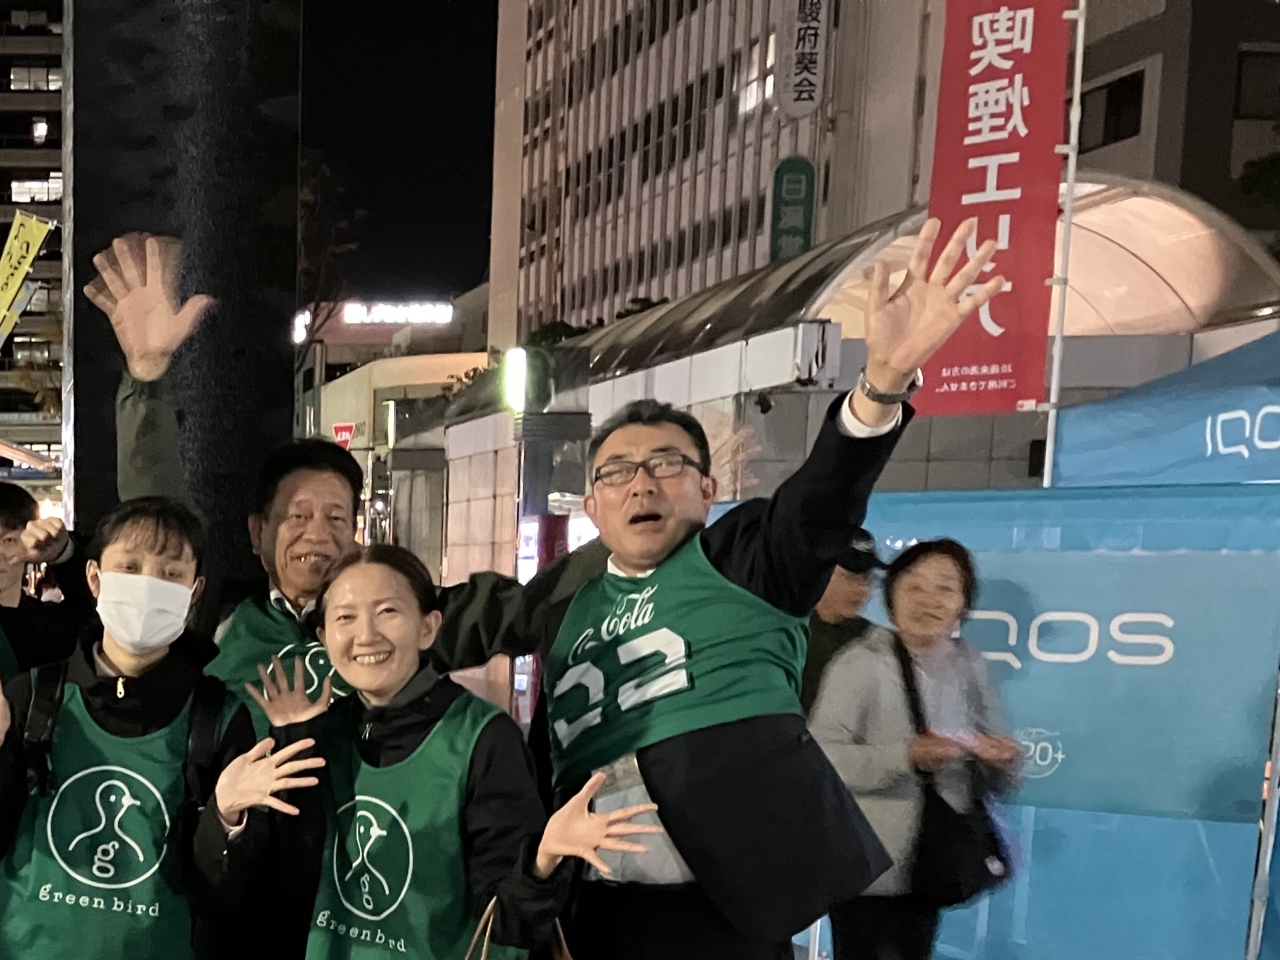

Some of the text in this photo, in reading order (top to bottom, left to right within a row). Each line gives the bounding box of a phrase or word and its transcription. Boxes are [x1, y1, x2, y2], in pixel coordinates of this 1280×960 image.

[951, 609, 1175, 670] QOS
[38, 883, 160, 917] green bird
[315, 909, 372, 942] green
